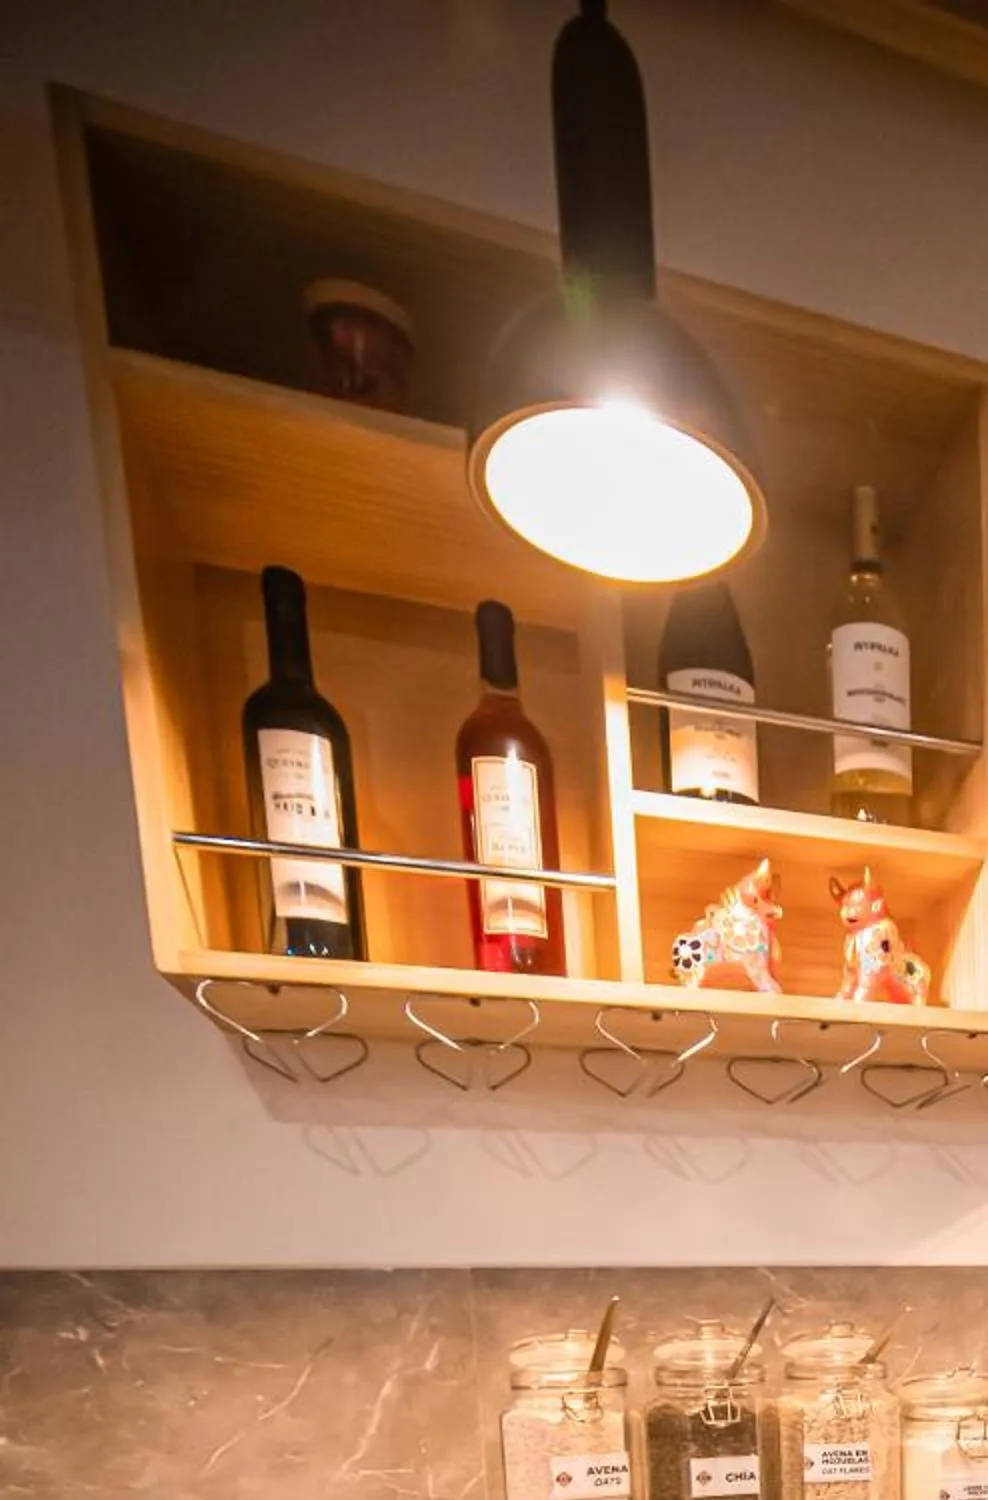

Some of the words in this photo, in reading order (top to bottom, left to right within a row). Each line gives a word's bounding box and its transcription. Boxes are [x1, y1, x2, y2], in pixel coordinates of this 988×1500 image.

[586, 1464, 629, 1476] AVENA
[593, 1477, 623, 1487] OATS
[725, 1472, 757, 1483] CHIA
